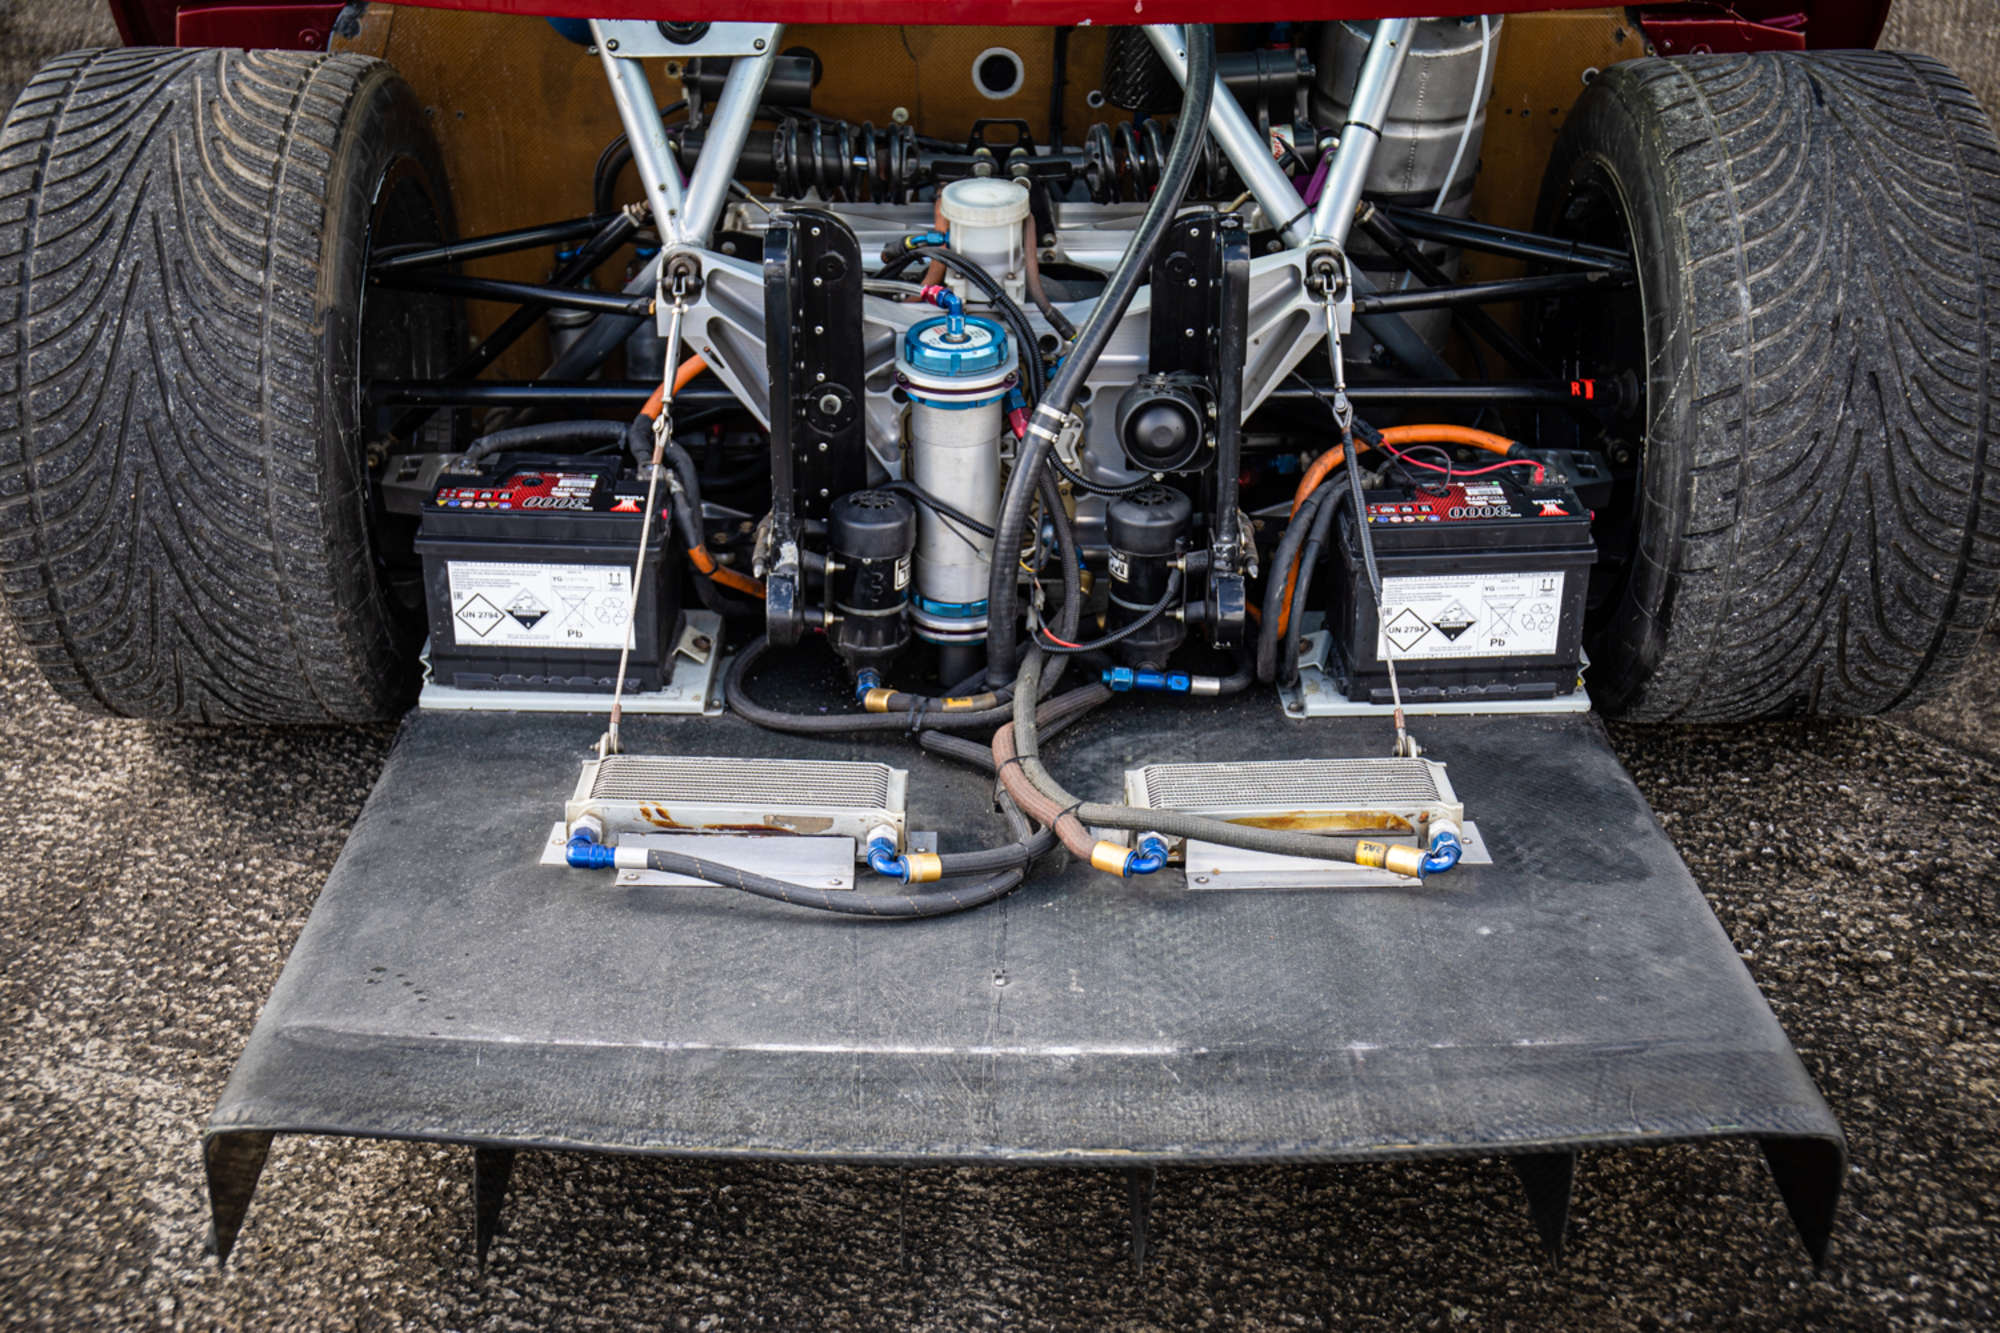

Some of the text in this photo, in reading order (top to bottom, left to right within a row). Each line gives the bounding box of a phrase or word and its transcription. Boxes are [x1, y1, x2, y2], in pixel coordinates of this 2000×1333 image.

[521, 496, 590, 510] 3000
[1448, 504, 1512, 519] 3000
[478, 611, 499, 619] 2794
[567, 629, 583, 638] Pb
[1403, 625, 1425, 633] 2794
[1490, 638, 1505, 647] Pb
